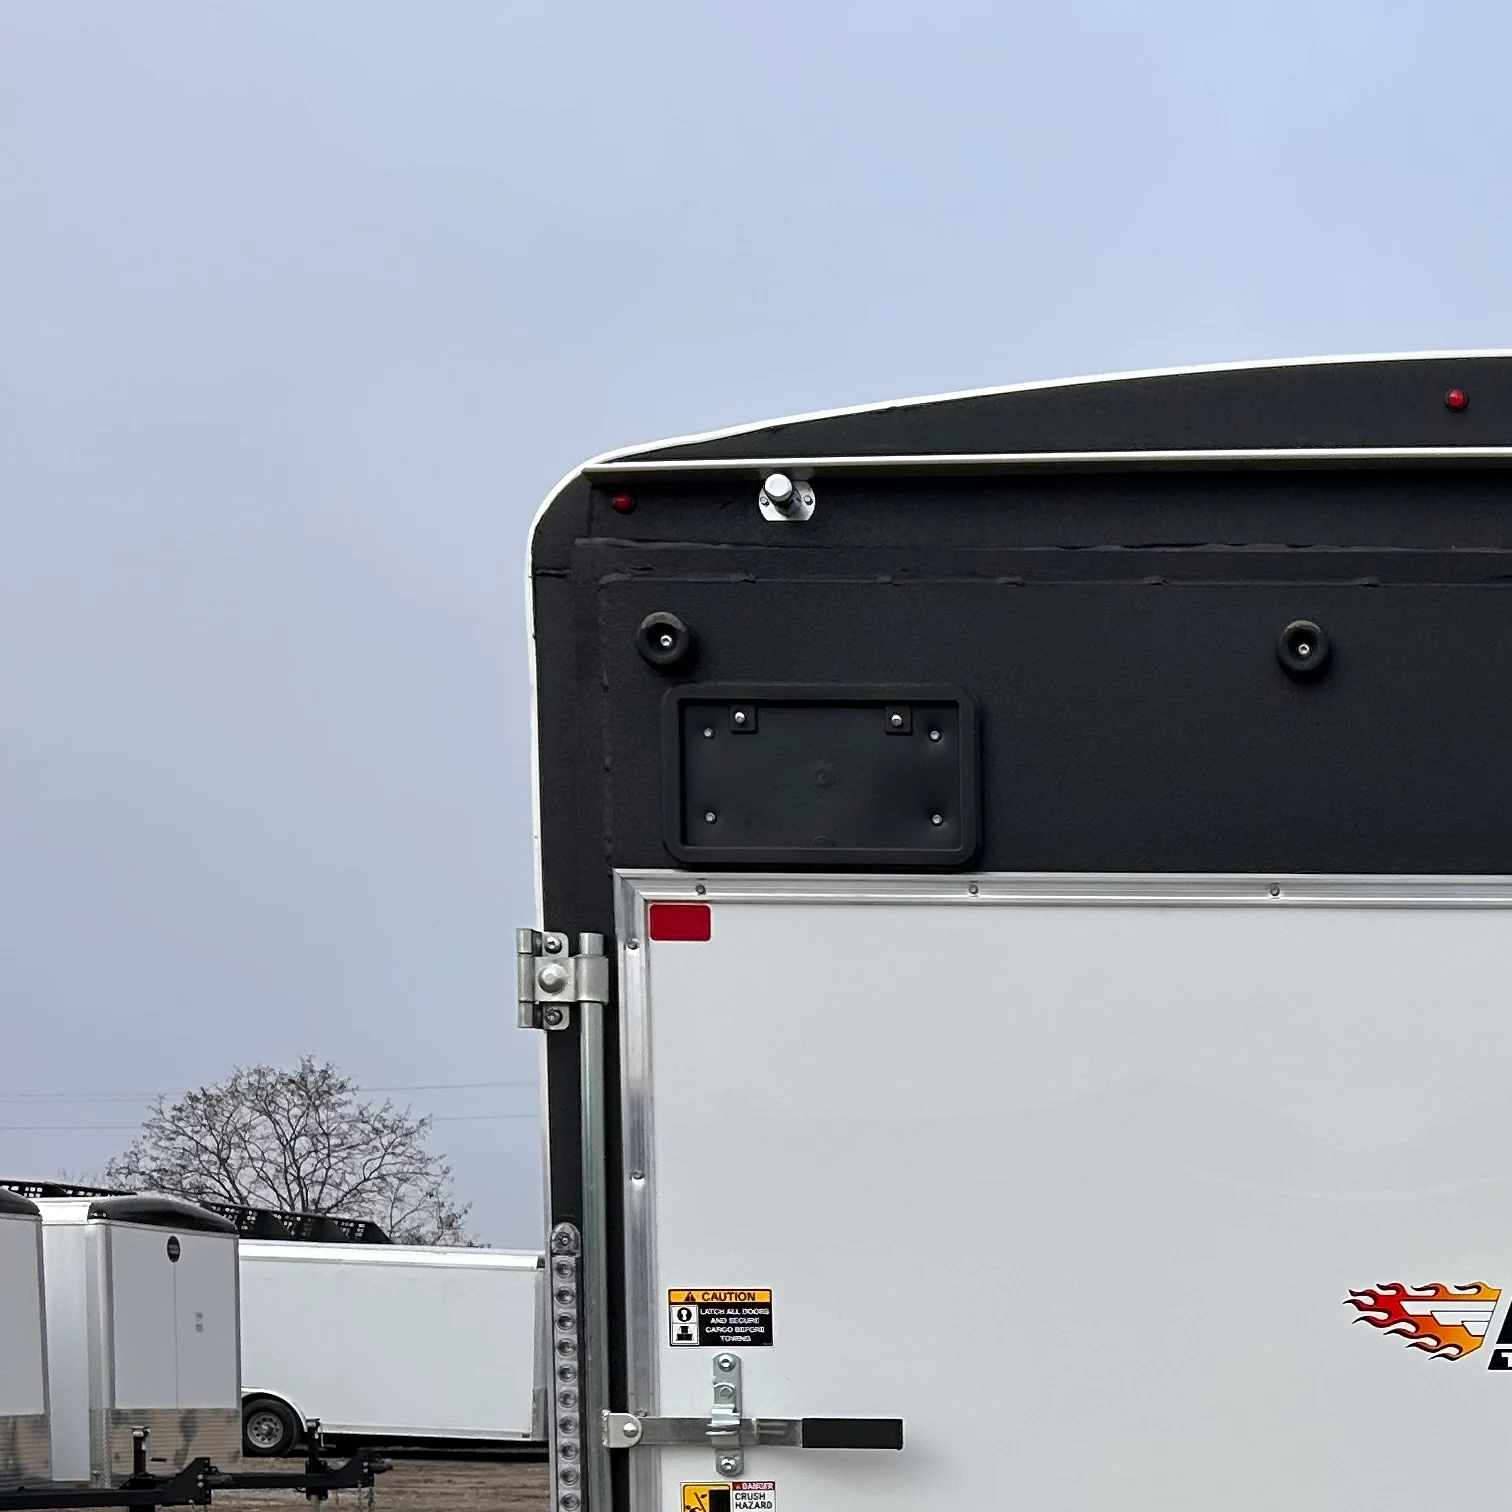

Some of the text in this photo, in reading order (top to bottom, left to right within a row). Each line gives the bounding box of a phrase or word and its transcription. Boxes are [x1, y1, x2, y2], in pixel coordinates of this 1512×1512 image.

[701, 1292, 756, 1301] CAUTION
[734, 1492, 766, 1501] CRUSH
[735, 1500, 773, 1510] HAZARD
